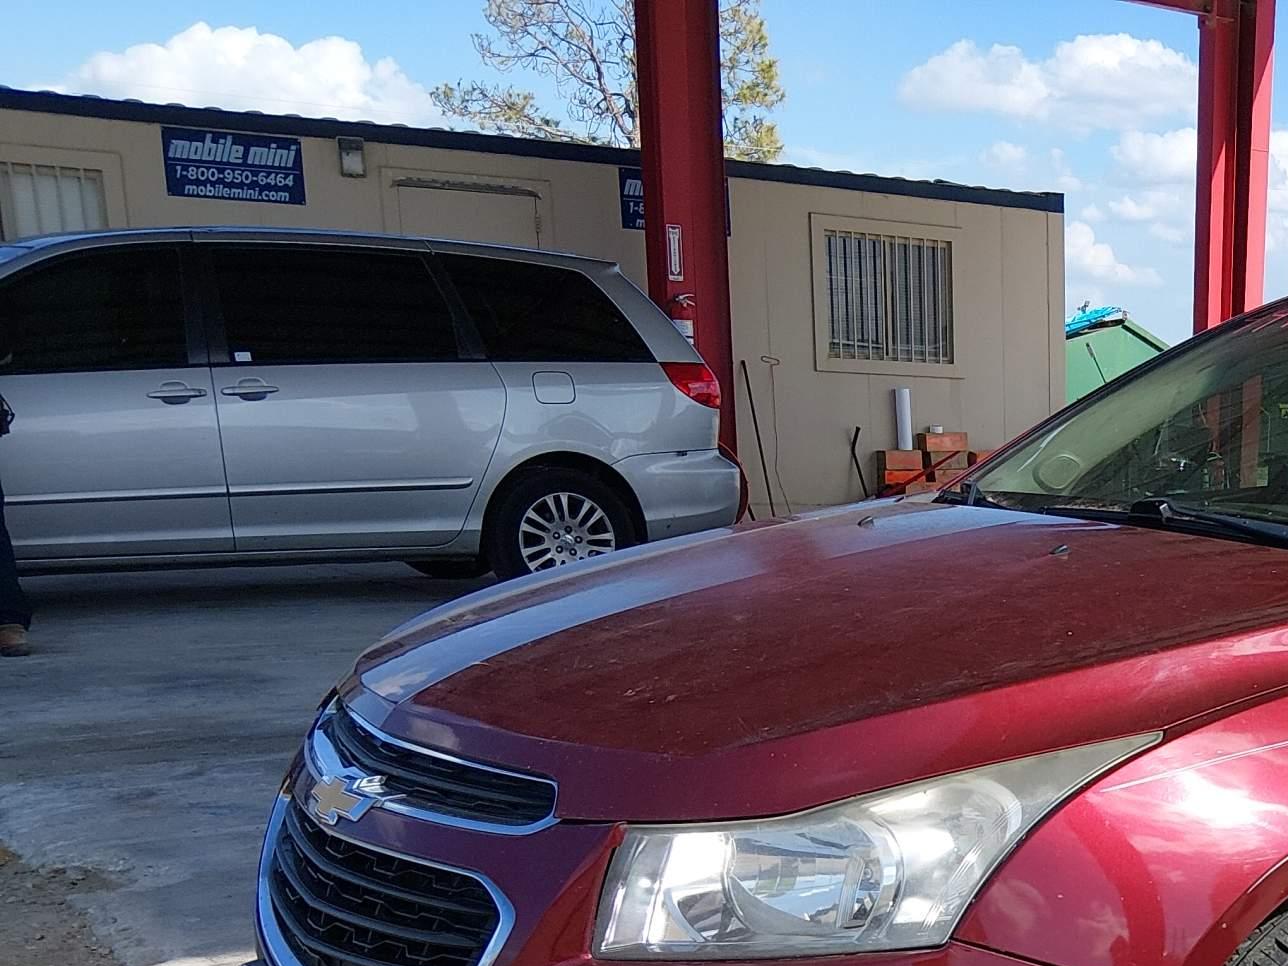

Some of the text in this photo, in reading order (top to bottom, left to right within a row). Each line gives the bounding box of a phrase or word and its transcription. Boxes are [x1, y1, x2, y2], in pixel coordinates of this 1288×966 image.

[168, 133, 297, 167] mobile mini
[175, 165, 294, 187] 1-800-950-6464
[184, 183, 290, 202] mobilemini.com
